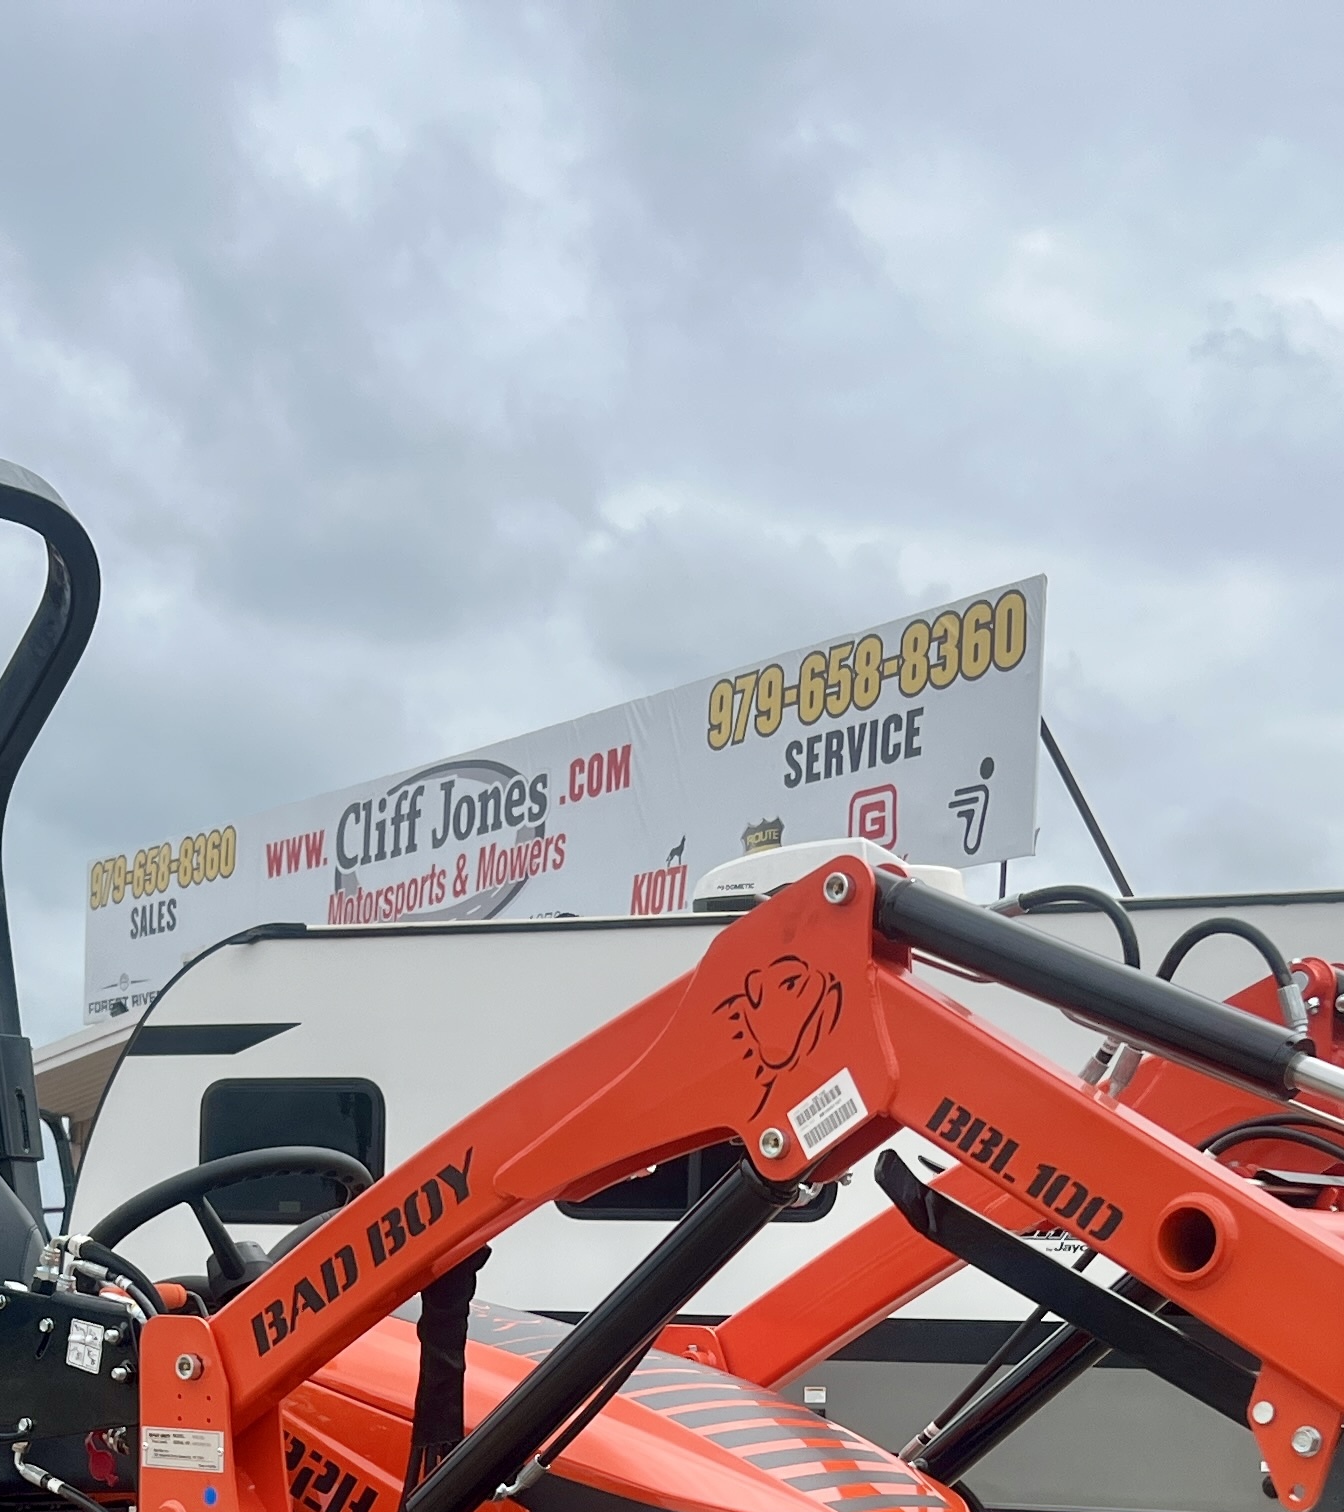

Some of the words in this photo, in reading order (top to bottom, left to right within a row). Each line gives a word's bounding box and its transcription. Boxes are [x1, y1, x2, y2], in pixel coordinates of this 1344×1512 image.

[707, 589, 1027, 751] 979-658-8360
[784, 707, 924, 788] SERVICE
[336, 785, 425, 870] Cliff
[432, 773, 548, 849] Jones
[559, 744, 632, 805] .COM
[747, 828, 780, 847] ROUTE
[89, 825, 237, 911] 979-658-8360
[328, 864, 446, 924] Motorsports
[453, 853, 469, 897] &
[476, 833, 567, 892] Mowers
[630, 865, 688, 916] KIOTI
[130, 899, 177, 940] SALES
[131, 990, 160, 1008] RIVE
[925, 1097, 1018, 1184] BBL
[1026, 1163, 1124, 1242] 100
[251, 1240, 358, 1357] BAD
[365, 1147, 476, 1265] BOY
